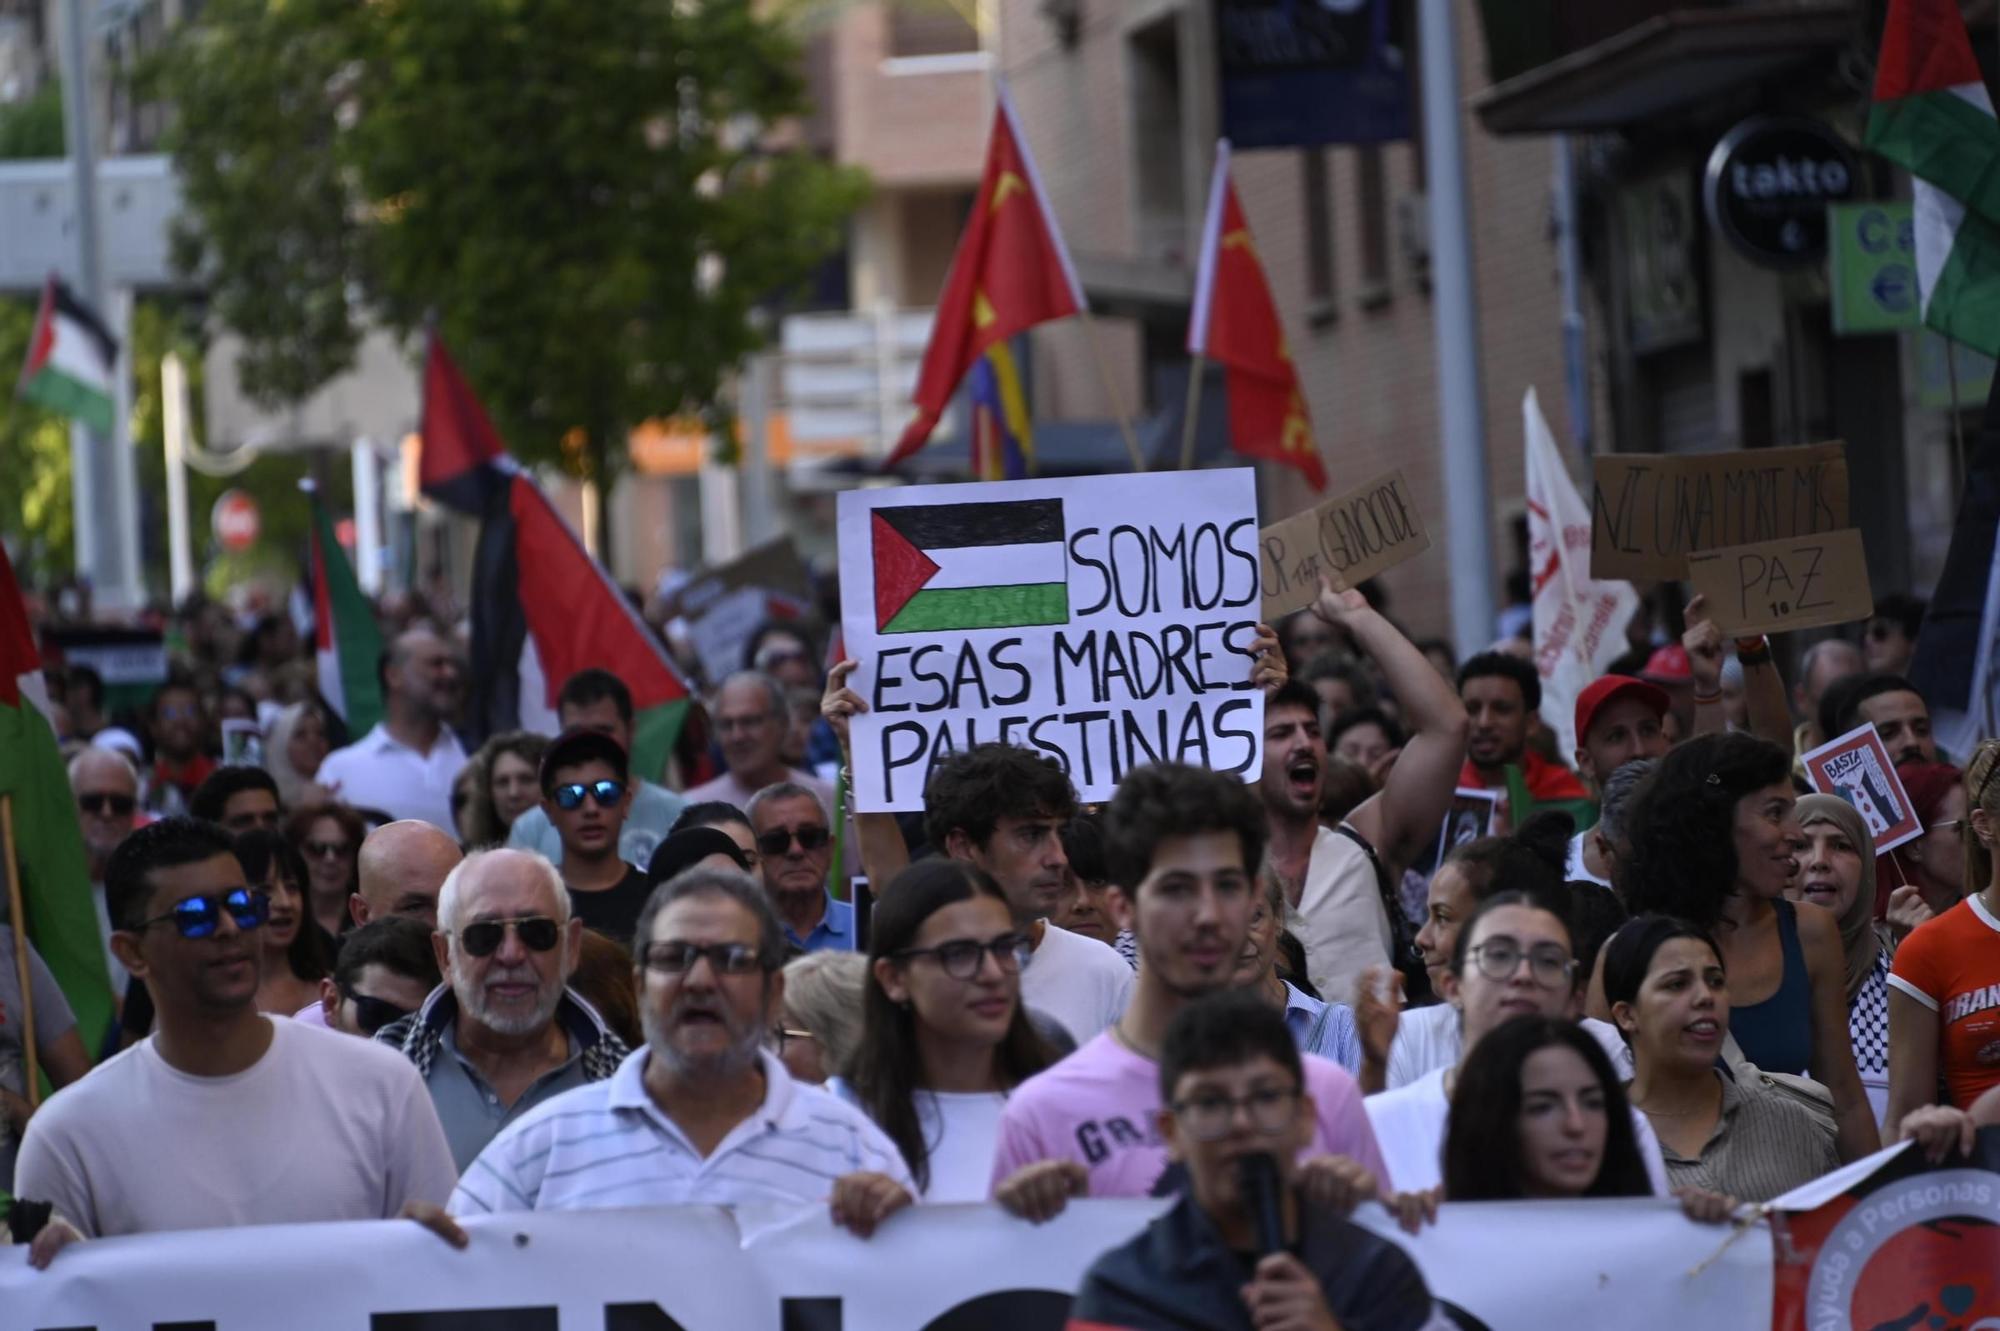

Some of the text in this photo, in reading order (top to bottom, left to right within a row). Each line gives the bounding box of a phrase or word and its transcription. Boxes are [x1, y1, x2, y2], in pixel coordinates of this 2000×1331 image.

[1732, 155, 1849, 199] takto
[1319, 480, 1418, 572] GENOCIDE
[1591, 466, 1651, 554] NI
[1069, 518, 1259, 617] SOMOS
[1737, 546, 1835, 620] PAZ
[873, 621, 1260, 713] ESAS MADRES
[1824, 749, 1862, 780] BASTA
[1859, 1181, 1992, 1234] Personas
